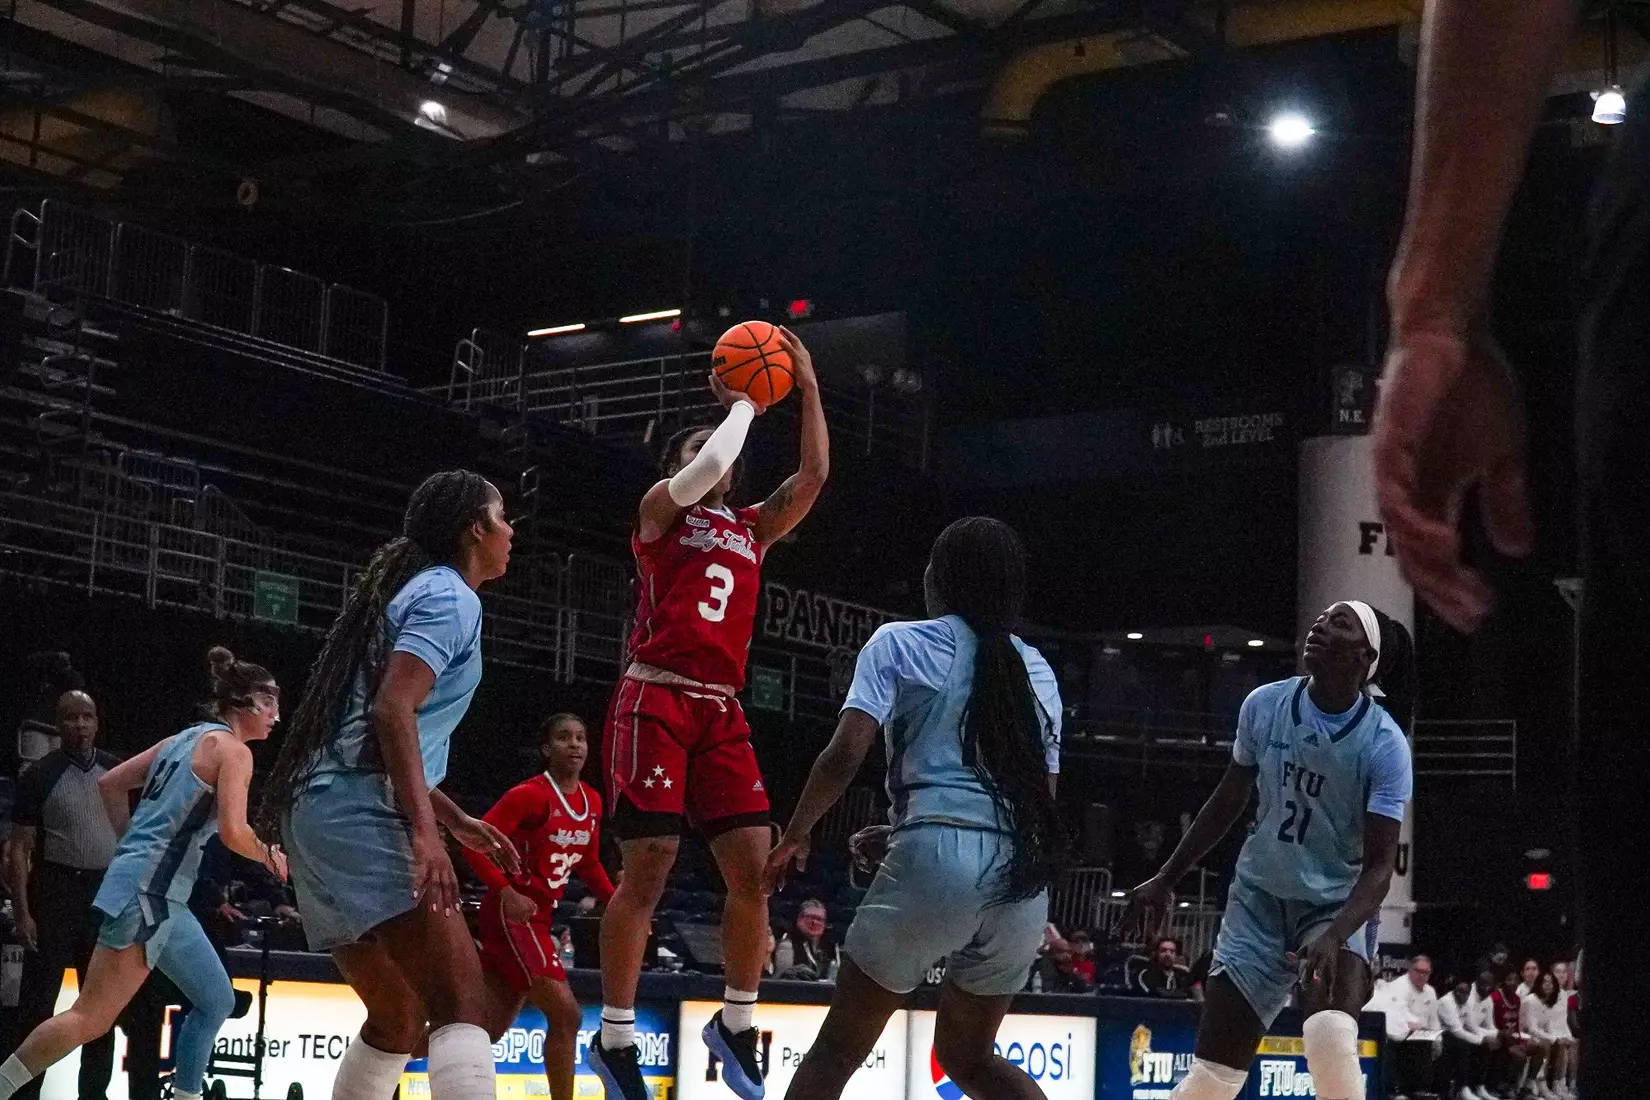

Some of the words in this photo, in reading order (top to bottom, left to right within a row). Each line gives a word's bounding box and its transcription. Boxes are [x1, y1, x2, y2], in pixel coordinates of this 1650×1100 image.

[697, 563, 735, 622] 3
[764, 580, 885, 651] PANTH
[1281, 761, 1325, 798] FIU
[1277, 800, 1314, 845] 21
[1143, 1052, 1174, 1083] FIU
